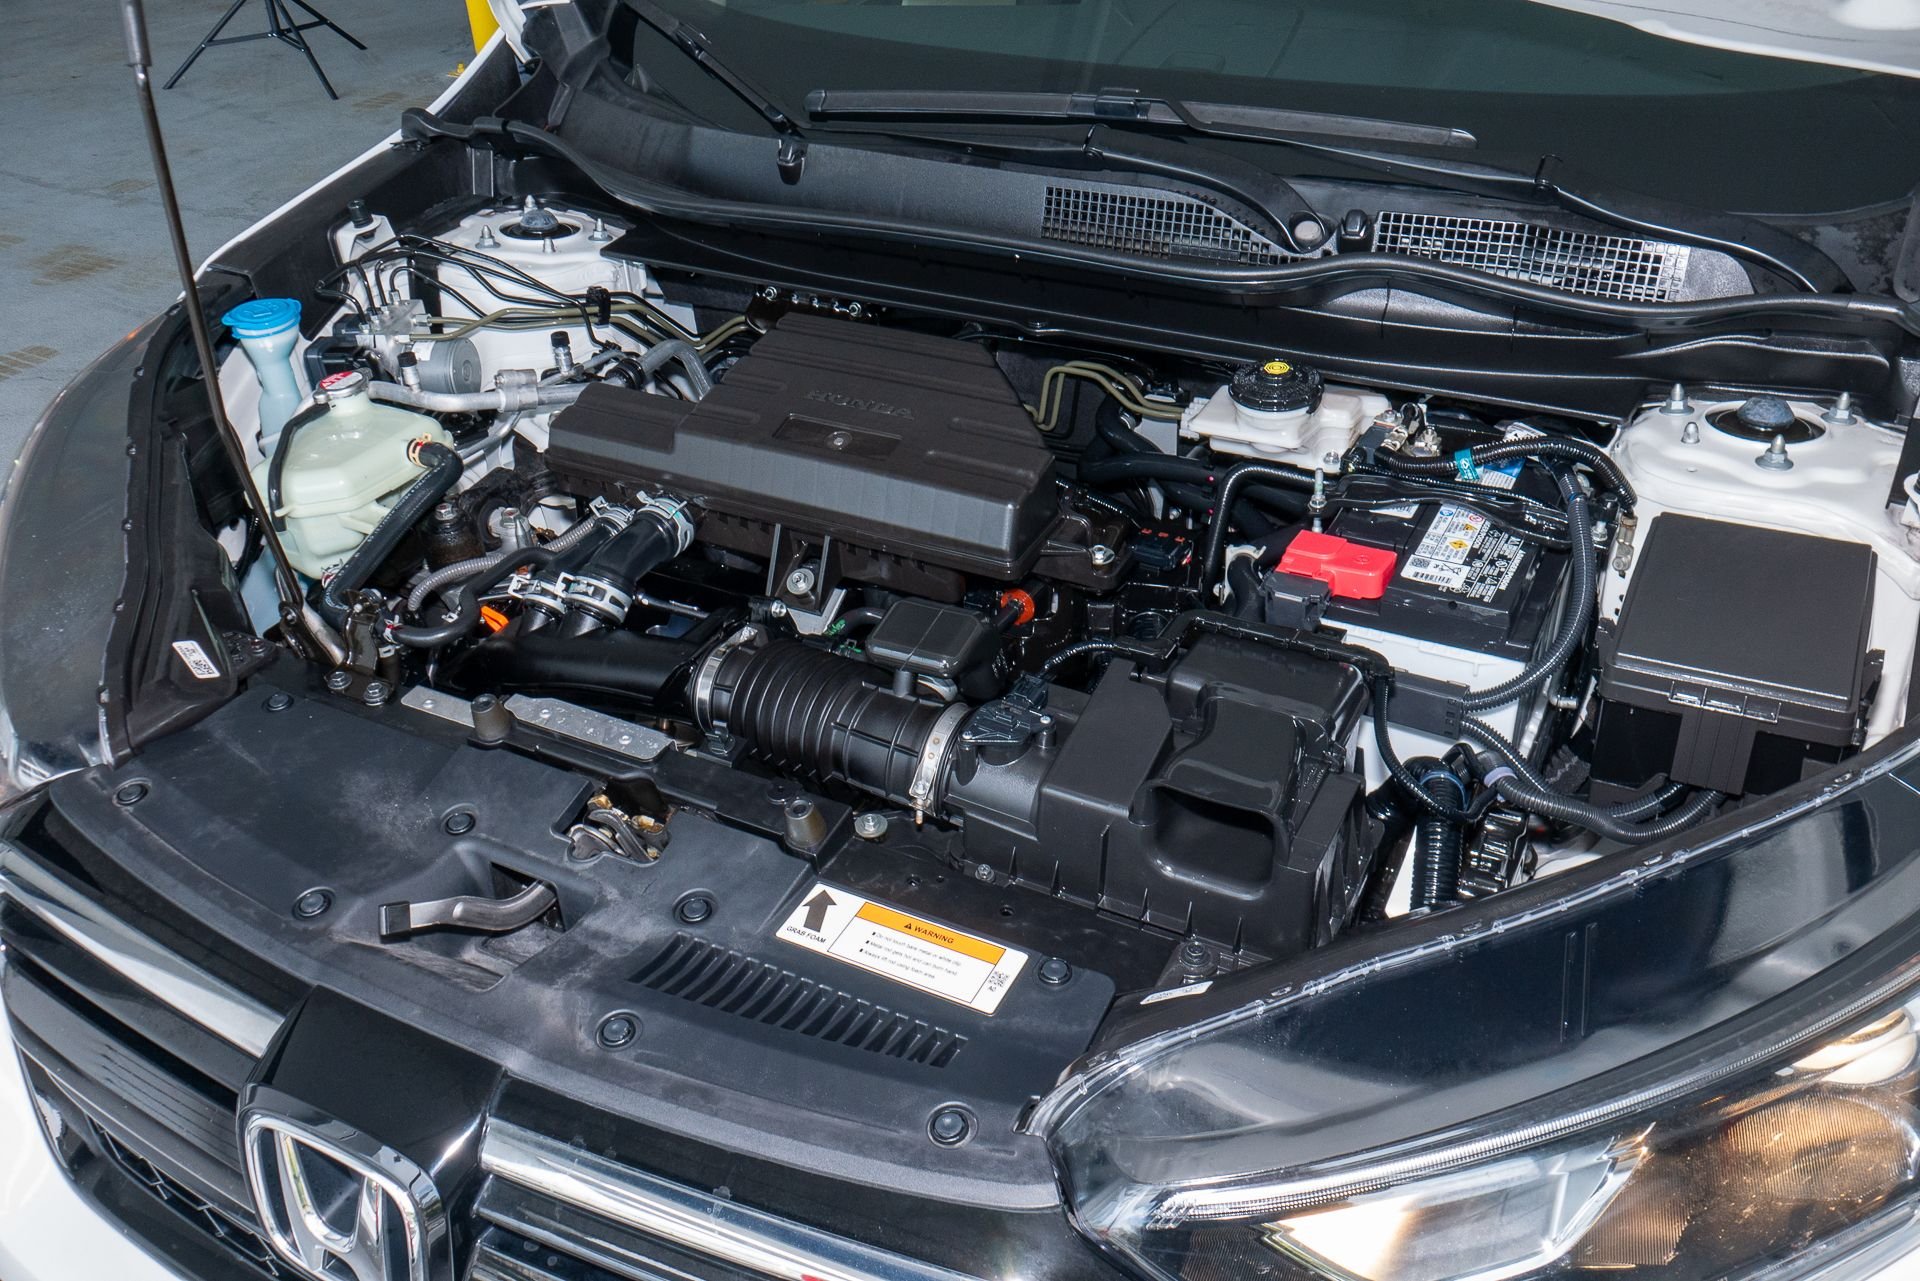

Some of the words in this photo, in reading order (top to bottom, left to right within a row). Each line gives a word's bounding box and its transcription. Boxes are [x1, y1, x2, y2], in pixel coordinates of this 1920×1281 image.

[786, 926, 806, 936] GRAB
[807, 932, 826, 943] FOAM
[915, 925, 954, 944] WARNING
